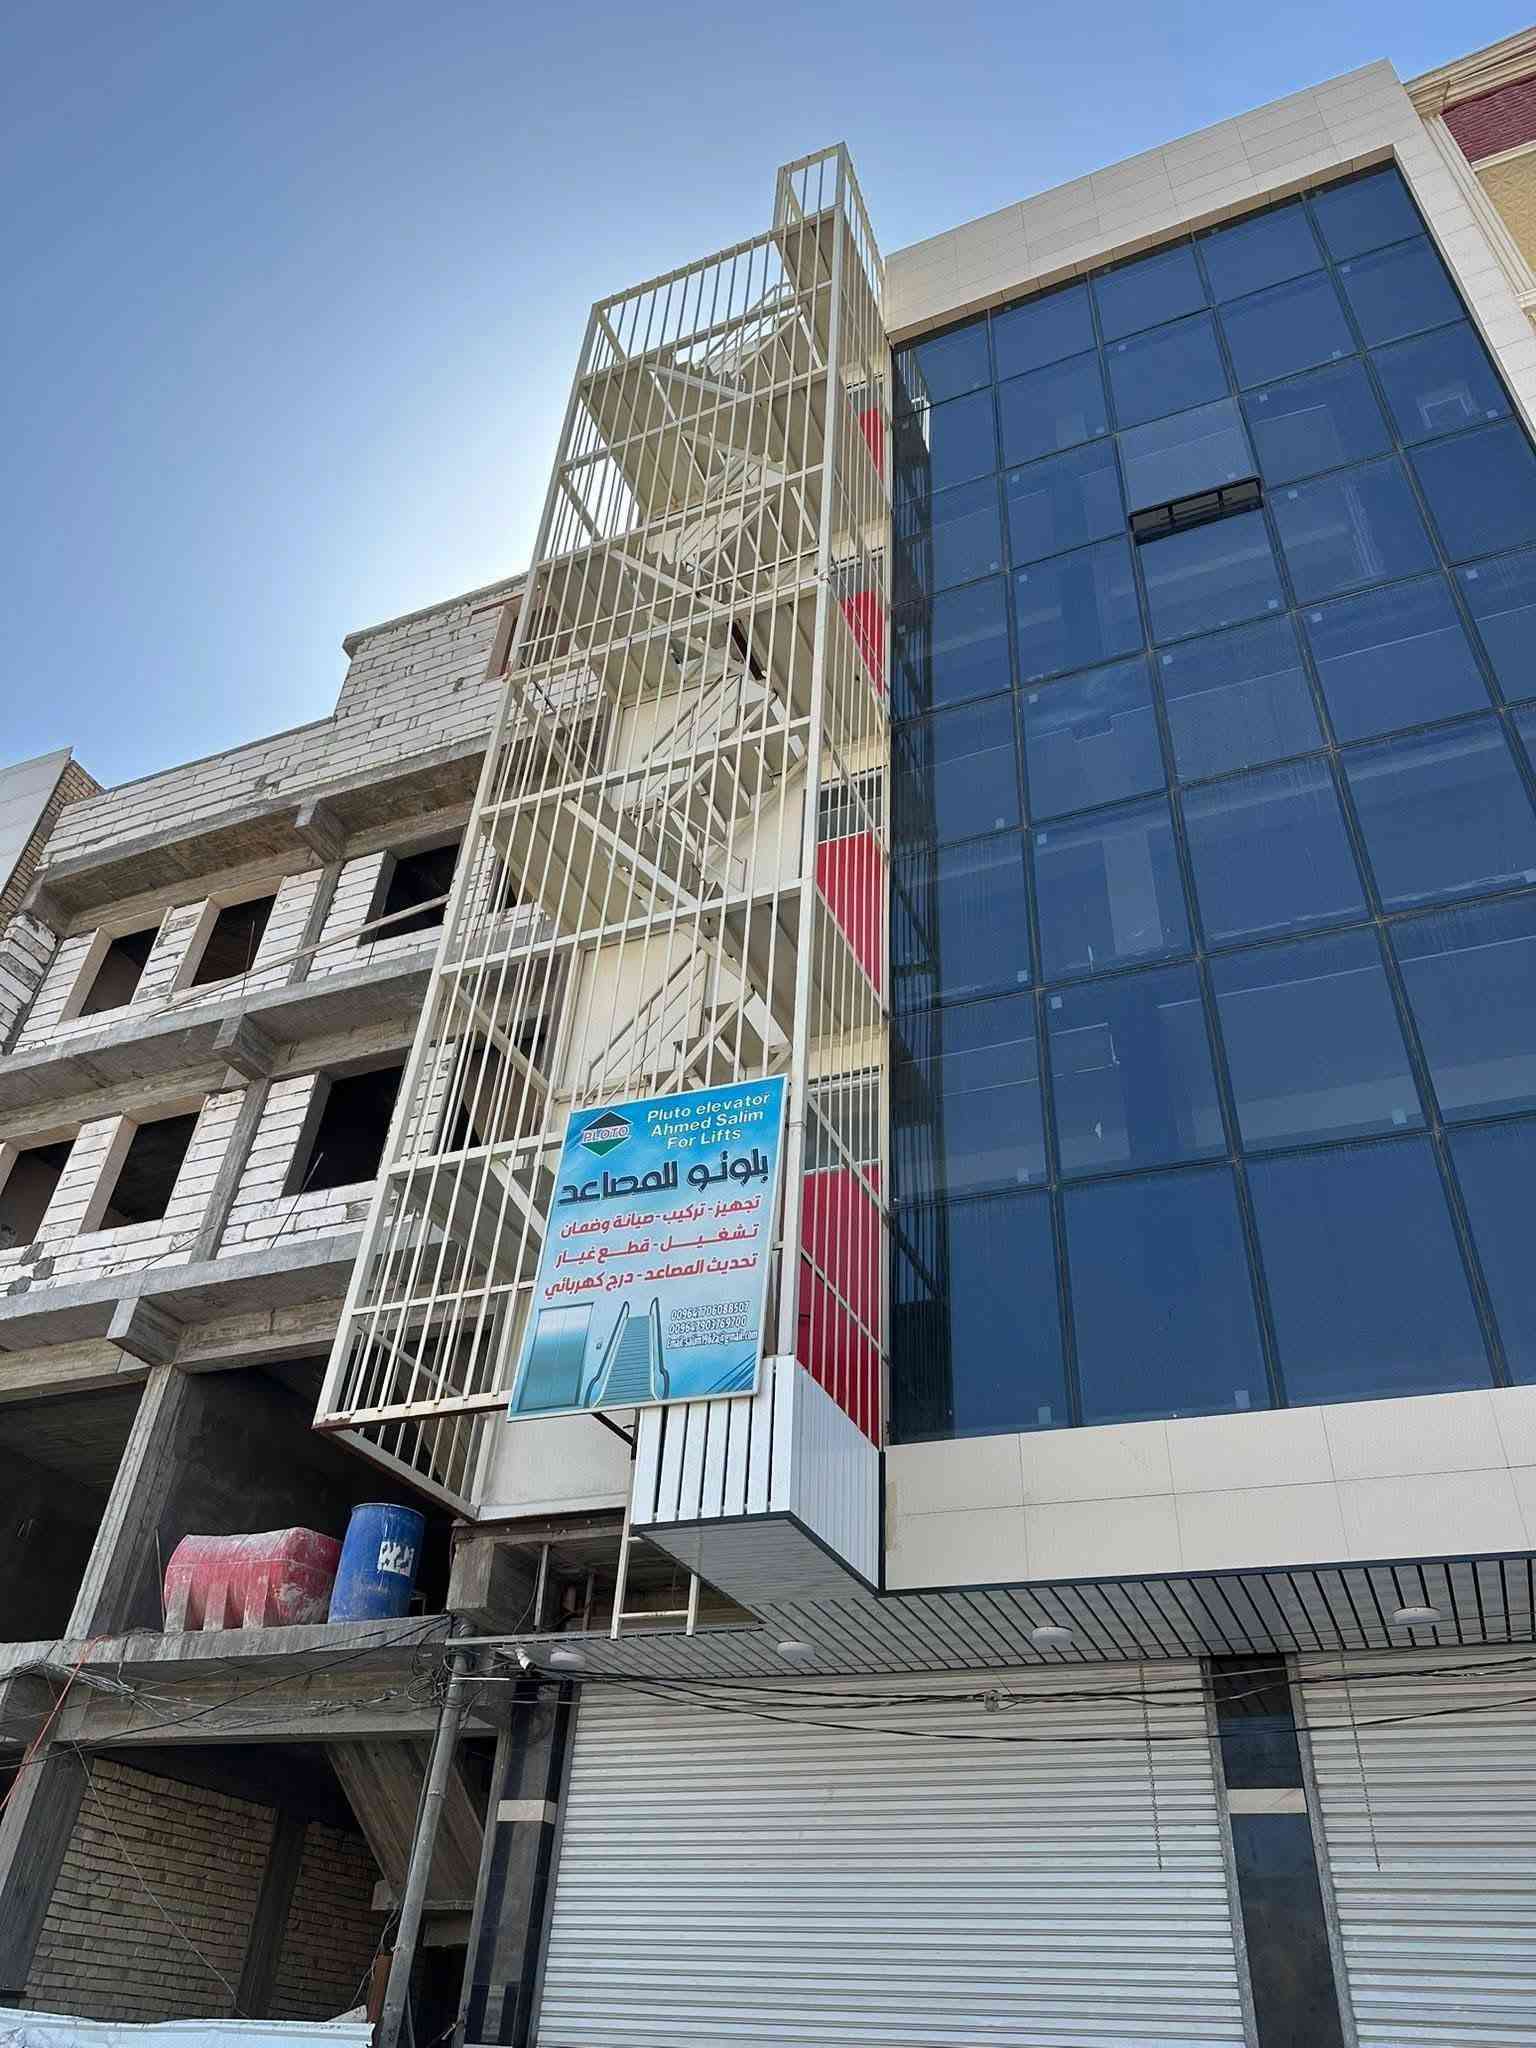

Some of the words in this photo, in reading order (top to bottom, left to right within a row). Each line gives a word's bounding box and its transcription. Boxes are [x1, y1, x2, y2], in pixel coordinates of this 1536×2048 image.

[647, 1108, 691, 1123] Pluto
[695, 1093, 770, 1114] elevator
[651, 1117, 711, 1137] Ahmed
[715, 1110, 763, 1127] Salim
[667, 1136, 694, 1150] For
[700, 1128, 742, 1145] Lifts
[687, 1148, 768, 1192] بلوتو
[558, 1160, 678, 1207] للمصاعد
[561, 1218, 610, 1238] وضمان
[555, 1246, 595, 1268] غيار
[706, 1254, 759, 1273] تحديث
[545, 1272, 605, 1300] كهربائي
[606, 1272, 633, 1292] درج
